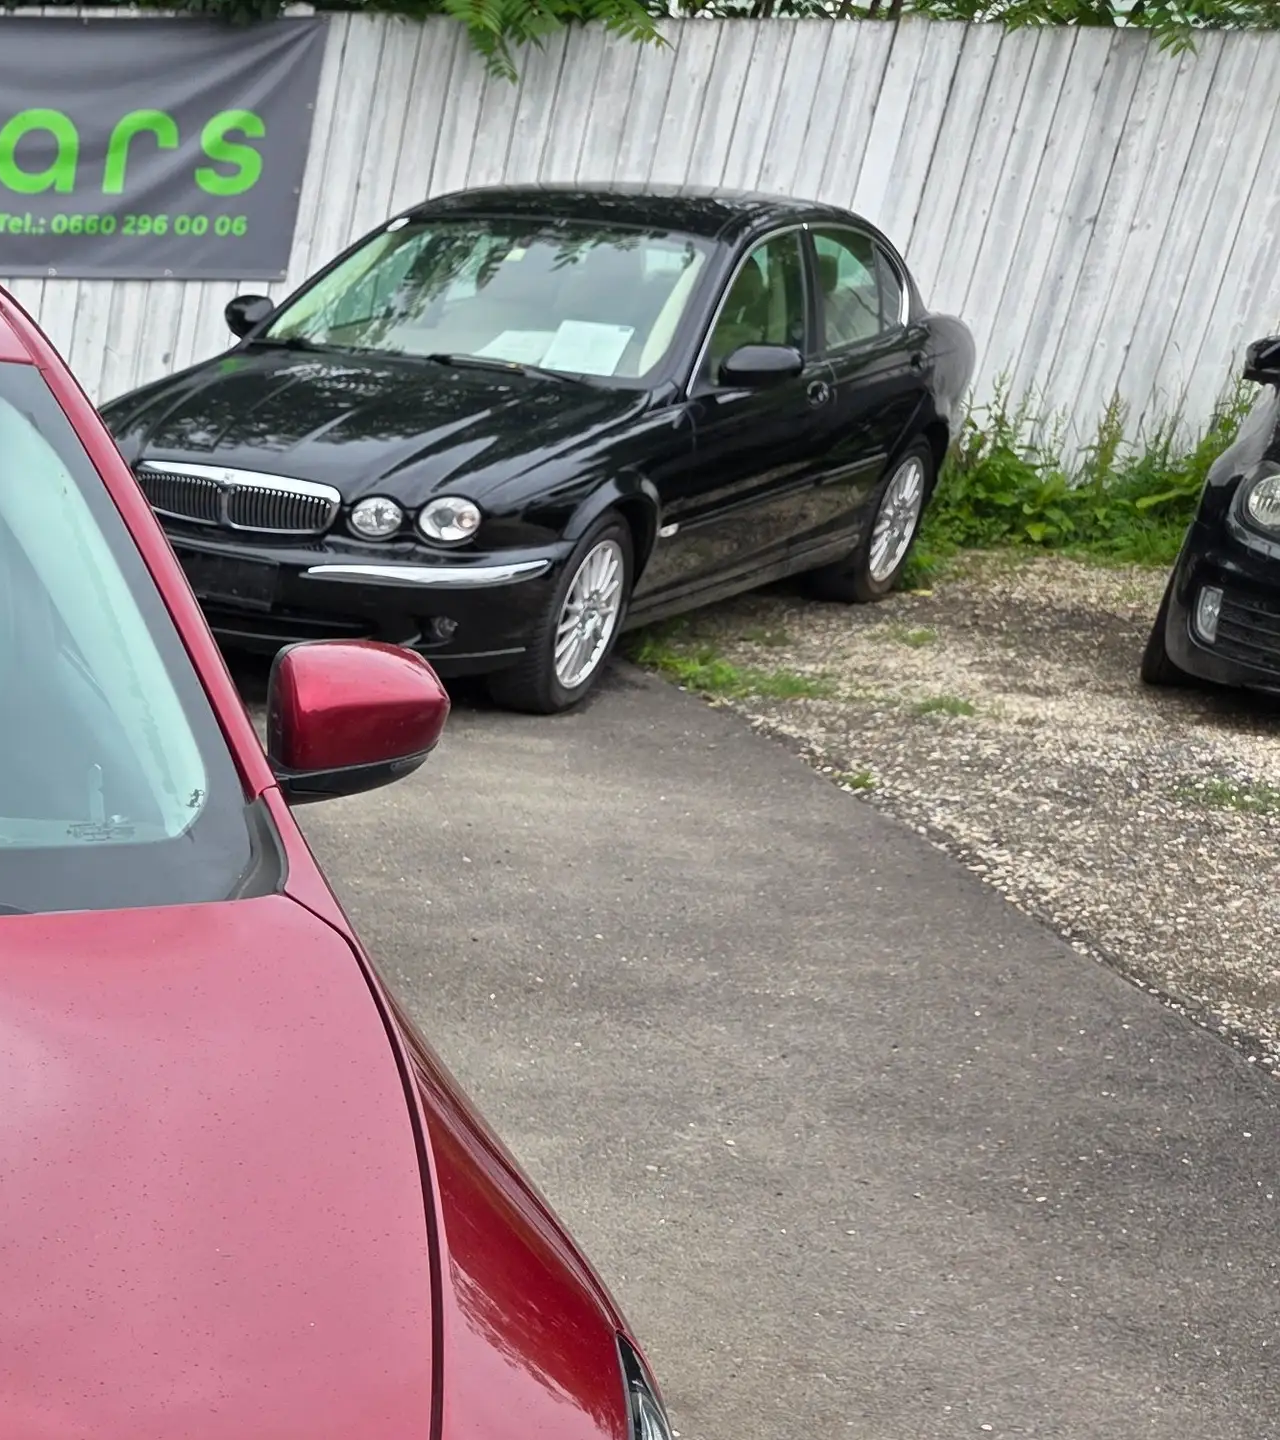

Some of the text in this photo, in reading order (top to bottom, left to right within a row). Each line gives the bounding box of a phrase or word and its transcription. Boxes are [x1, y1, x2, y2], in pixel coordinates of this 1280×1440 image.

[51, 213, 116, 235] 0660
[121, 214, 168, 236] 296
[173, 215, 208, 236] 00
[214, 215, 247, 236] 06
